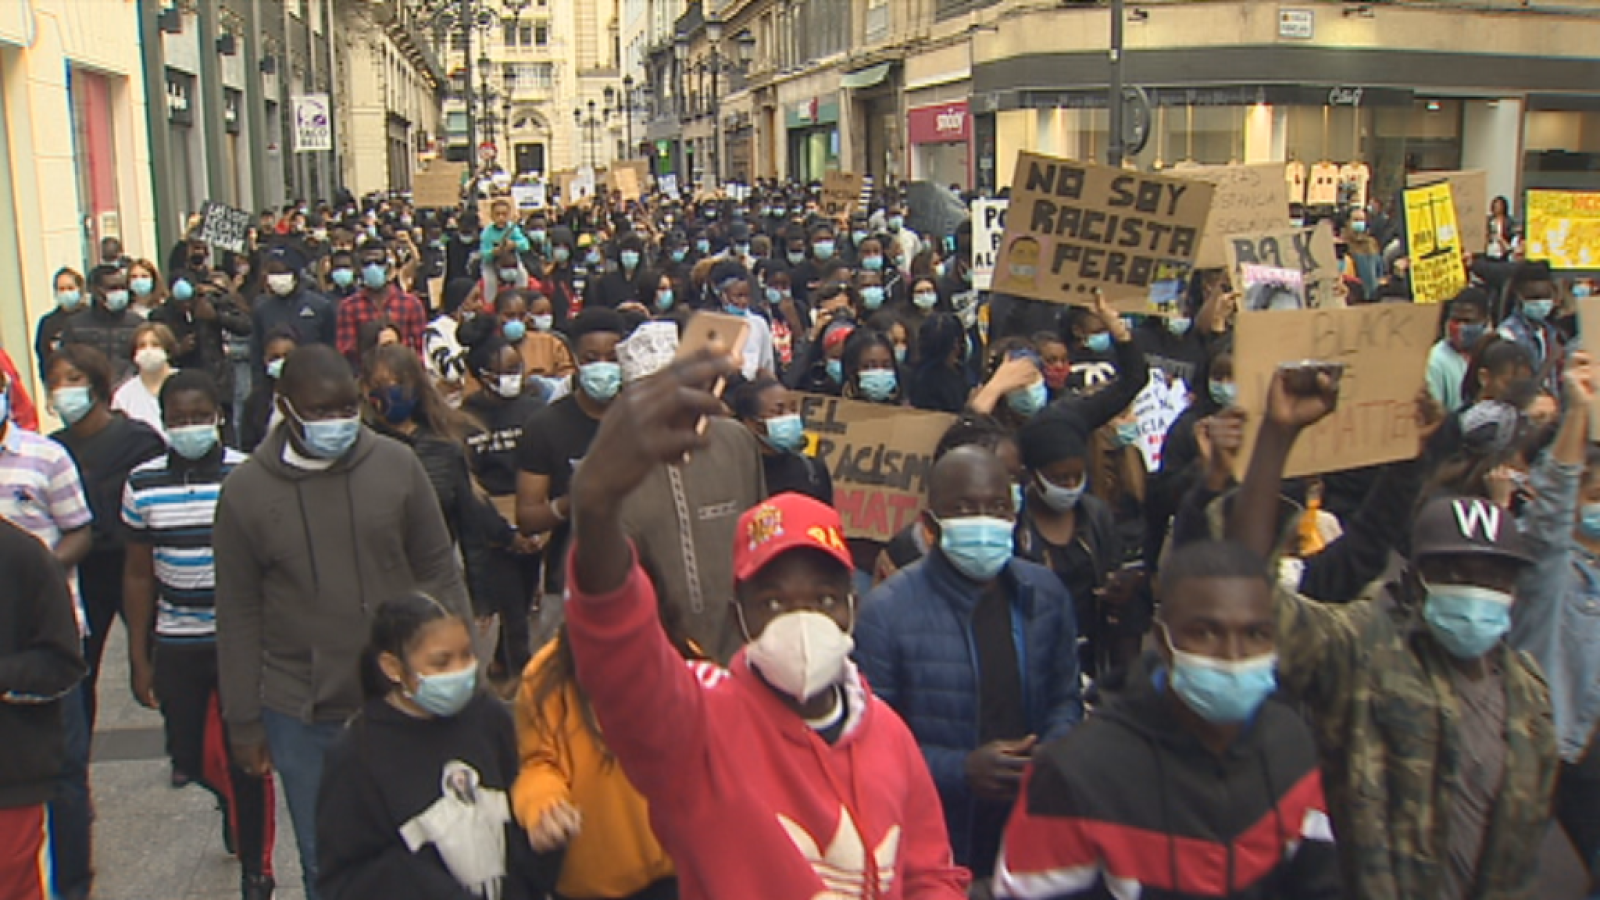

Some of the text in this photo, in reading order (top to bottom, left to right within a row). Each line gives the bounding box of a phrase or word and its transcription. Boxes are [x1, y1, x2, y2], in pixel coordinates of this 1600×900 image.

[1025, 161, 1086, 199] NO
[1108, 175, 1187, 215] SOY
[1031, 199, 1197, 256] RACISTA
[1051, 243, 1154, 287] PERO
[1311, 308, 1414, 357] BLACK
[802, 397, 847, 434] EL
[834, 488, 926, 535] MAT
[1452, 499, 1500, 542] W
